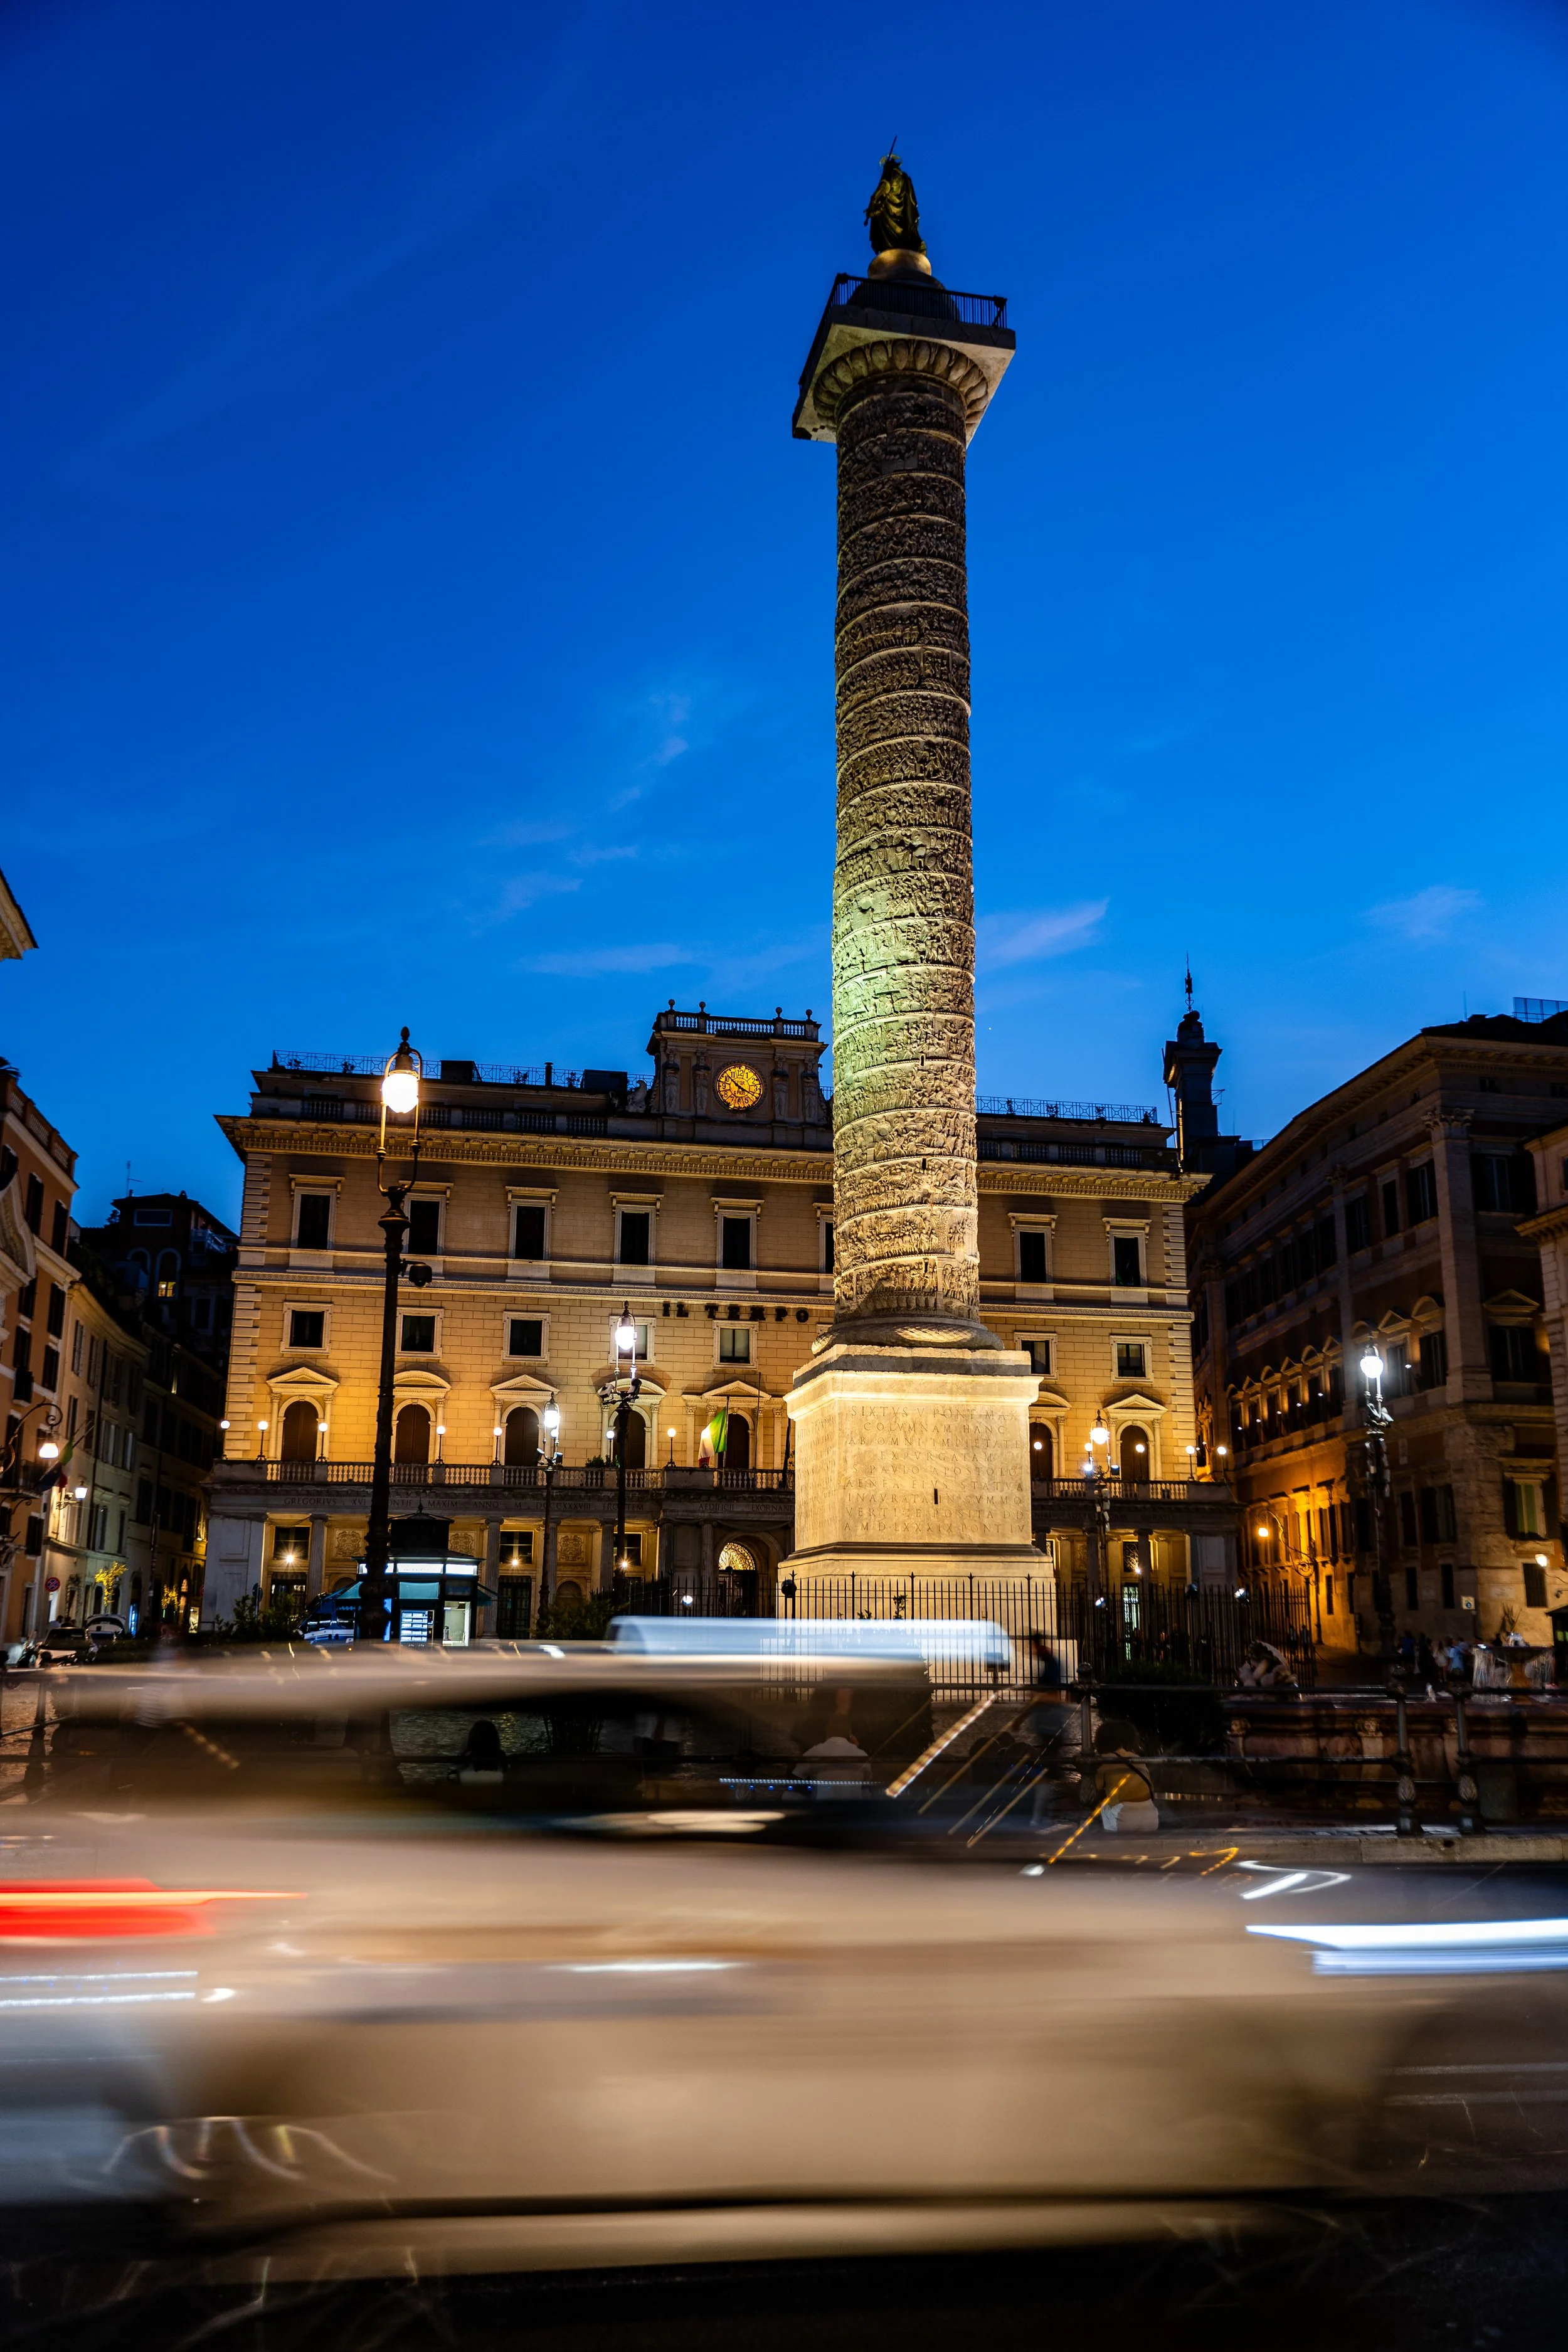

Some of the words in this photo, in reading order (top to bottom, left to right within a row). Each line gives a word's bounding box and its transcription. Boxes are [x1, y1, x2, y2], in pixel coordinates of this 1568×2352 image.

[662, 1302, 689, 1318] IL
[704, 1303, 809, 1323] TEMPO
[851, 1406, 908, 1417] SIXTVS
[918, 1407, 924, 1416] V
[934, 1408, 976, 1419] PONT
[985, 1409, 1018, 1421] MAX
[864, 1422, 951, 1433] COLVMNAM
[963, 1424, 1005, 1434] HANC
[849, 1436, 866, 1445] AB
[877, 1436, 921, 1446] OMNI
[933, 1438, 1020, 1449] IMPIETATE
[881, 1451, 992, 1462] EXPVRGATAM
[870, 1465, 919, 1475] PAVLO
[932, 1466, 1017, 1476] APOSTOLO
[845, 1479, 899, 1489] AENEA
[912, 1480, 948, 1489] EIVS
[960, 1481, 1024, 1492] STATVA
[848, 1493, 928, 1503] INAVRATA
[939, 1493, 954, 1503] IN
[965, 1495, 1022, 1505] SVMMO
[603, 1503, 644, 1511] FROTEM
[846, 1507, 922, 1517] VERTICE
[933, 1508, 993, 1518] POSITA
[961, 1523, 1002, 1534] PONT
[1010, 1524, 1025, 1534] IV
